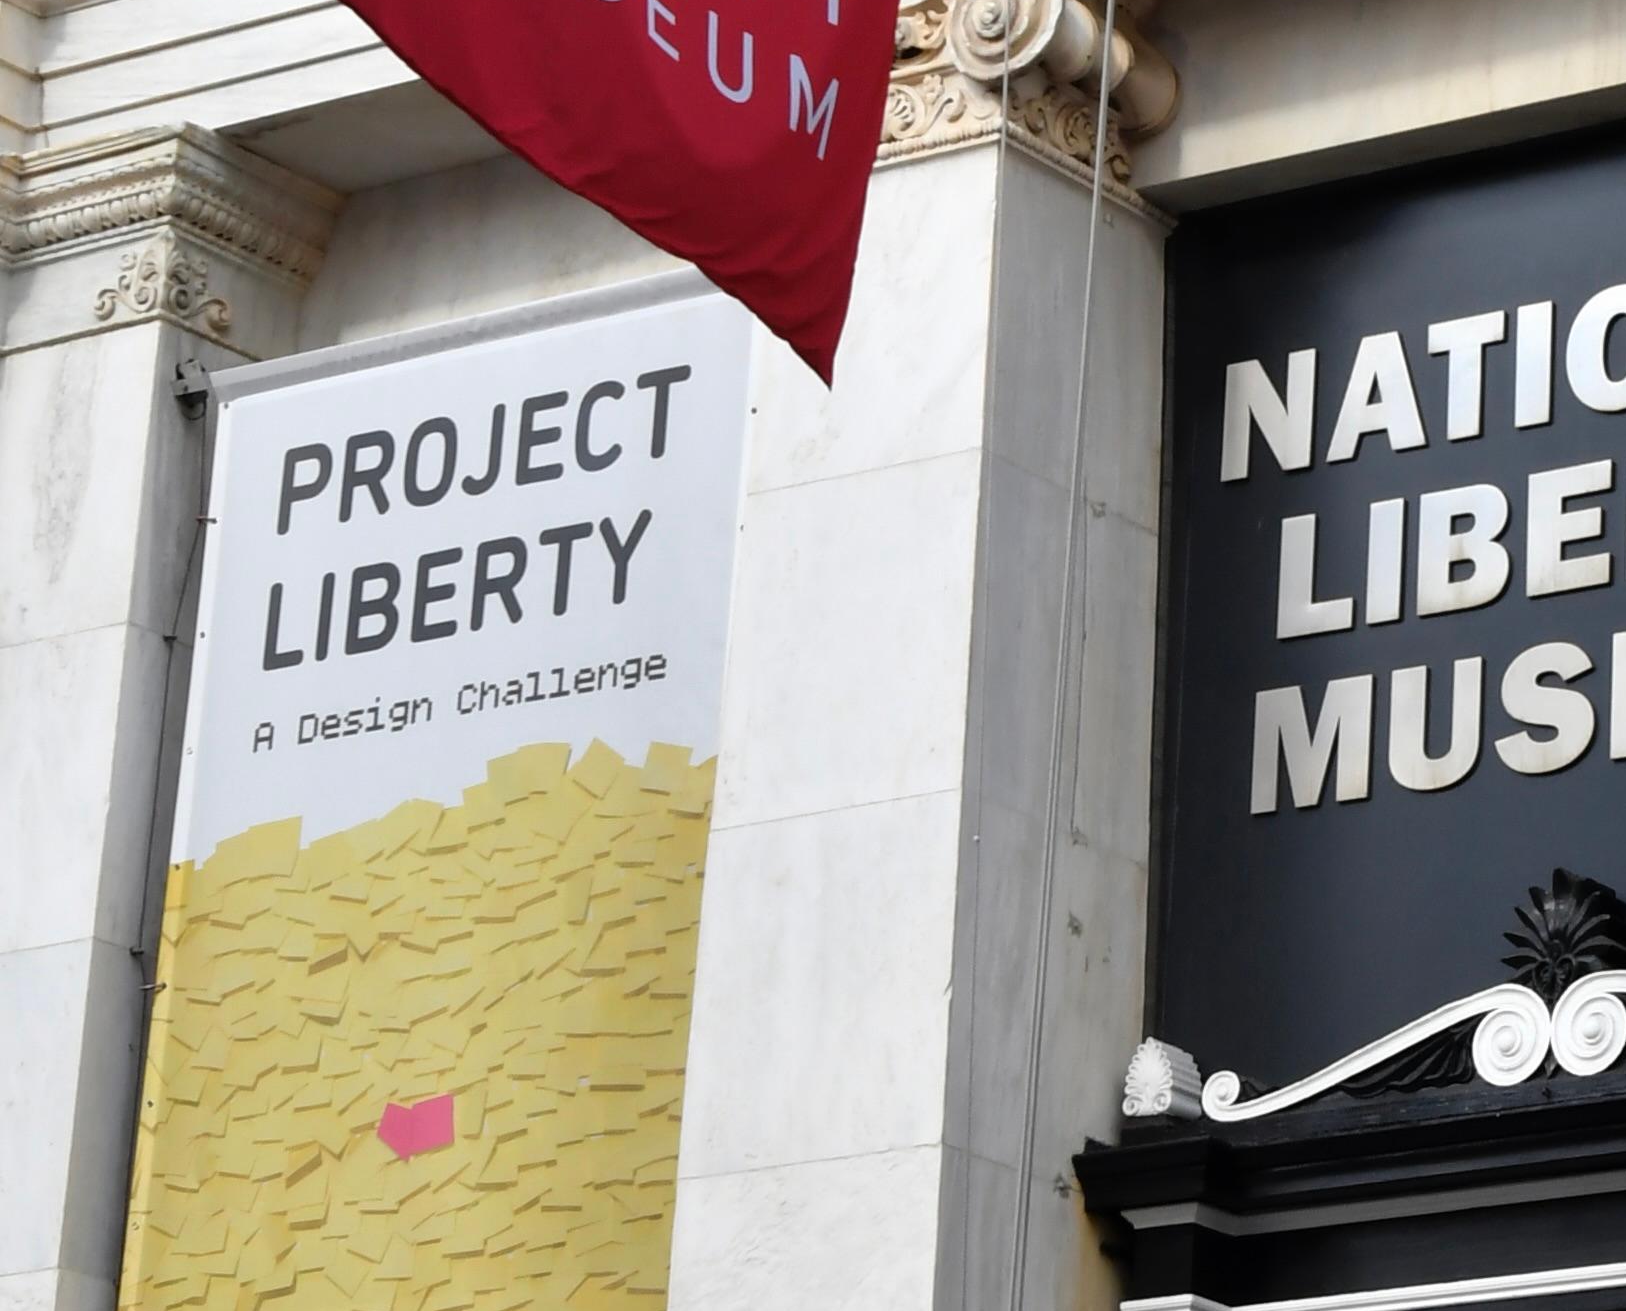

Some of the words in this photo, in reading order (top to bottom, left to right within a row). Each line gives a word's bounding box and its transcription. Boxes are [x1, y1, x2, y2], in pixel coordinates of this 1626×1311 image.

[277, 365, 692, 535] PROJECT
[262, 509, 653, 671] LIBERTY
[253, 720, 274, 754] A
[298, 694, 433, 746] Design
[458, 653, 668, 716] Challenge
